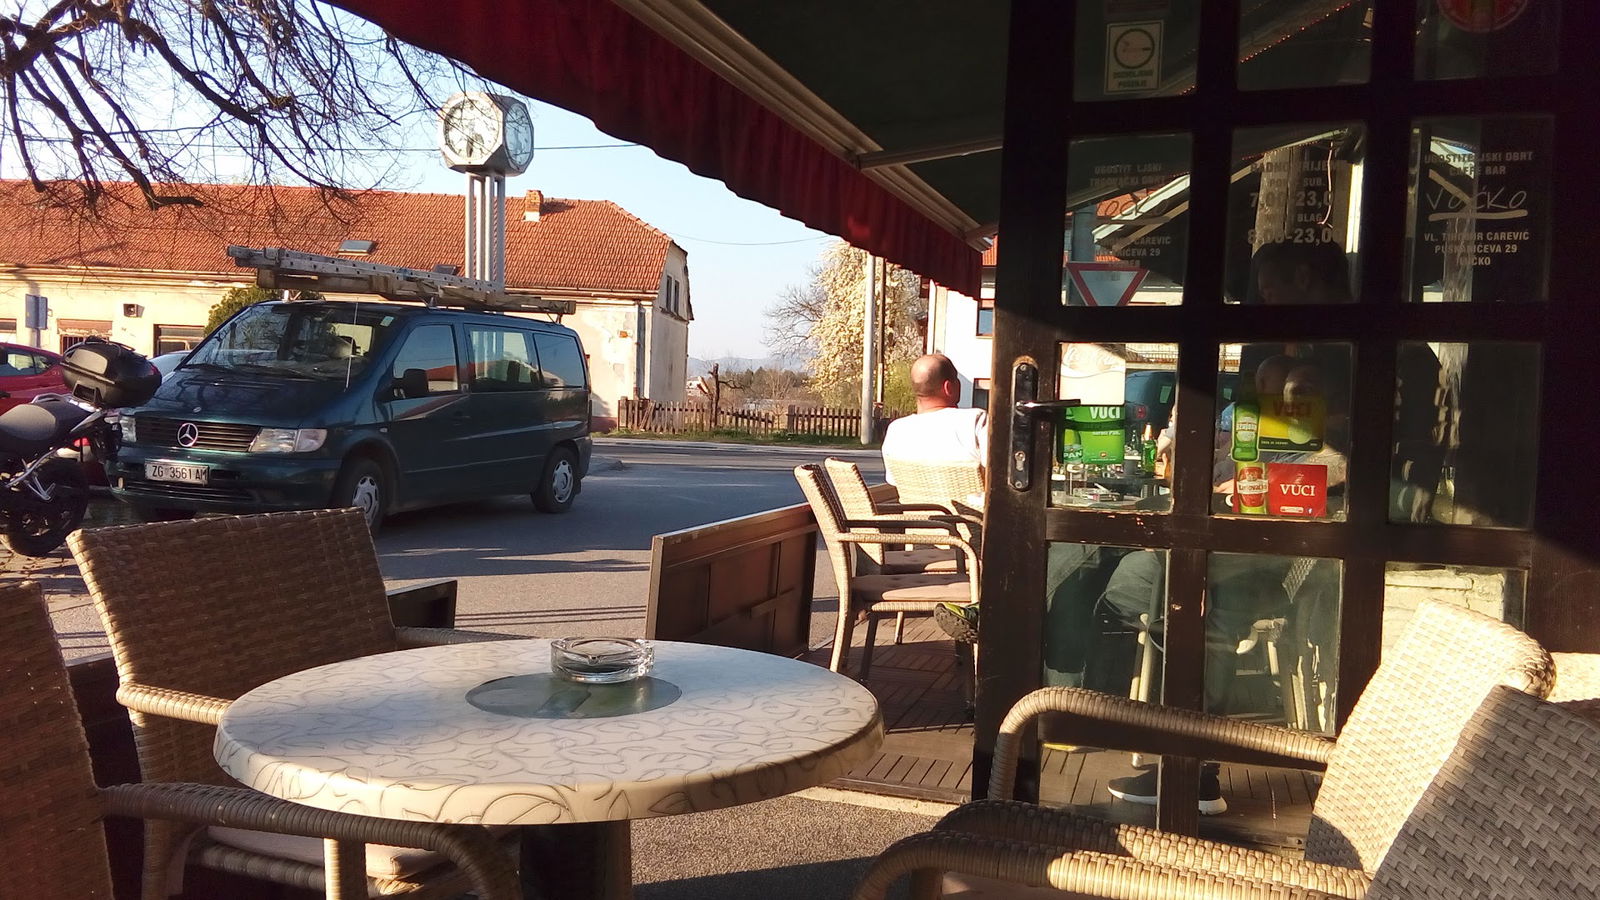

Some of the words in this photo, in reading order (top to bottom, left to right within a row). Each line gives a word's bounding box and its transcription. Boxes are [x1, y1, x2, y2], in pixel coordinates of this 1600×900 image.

[1424, 153, 1502, 164] UGOSTITEJSKI
[1505, 151, 1535, 162] OBRT
[1094, 163, 1162, 175] UGOSTITLJSKI
[1484, 165, 1507, 176] BAR
[1296, 213, 1326, 224] BLAG
[1149, 247, 1161, 257] 29
[1505, 243, 1518, 253] 29
[1089, 406, 1121, 419] VUCI
[1063, 450, 1083, 459] PAN
[152, 465, 164, 477] ZG
[169, 466, 192, 480] 3561
[1279, 483, 1316, 497] VUCI
